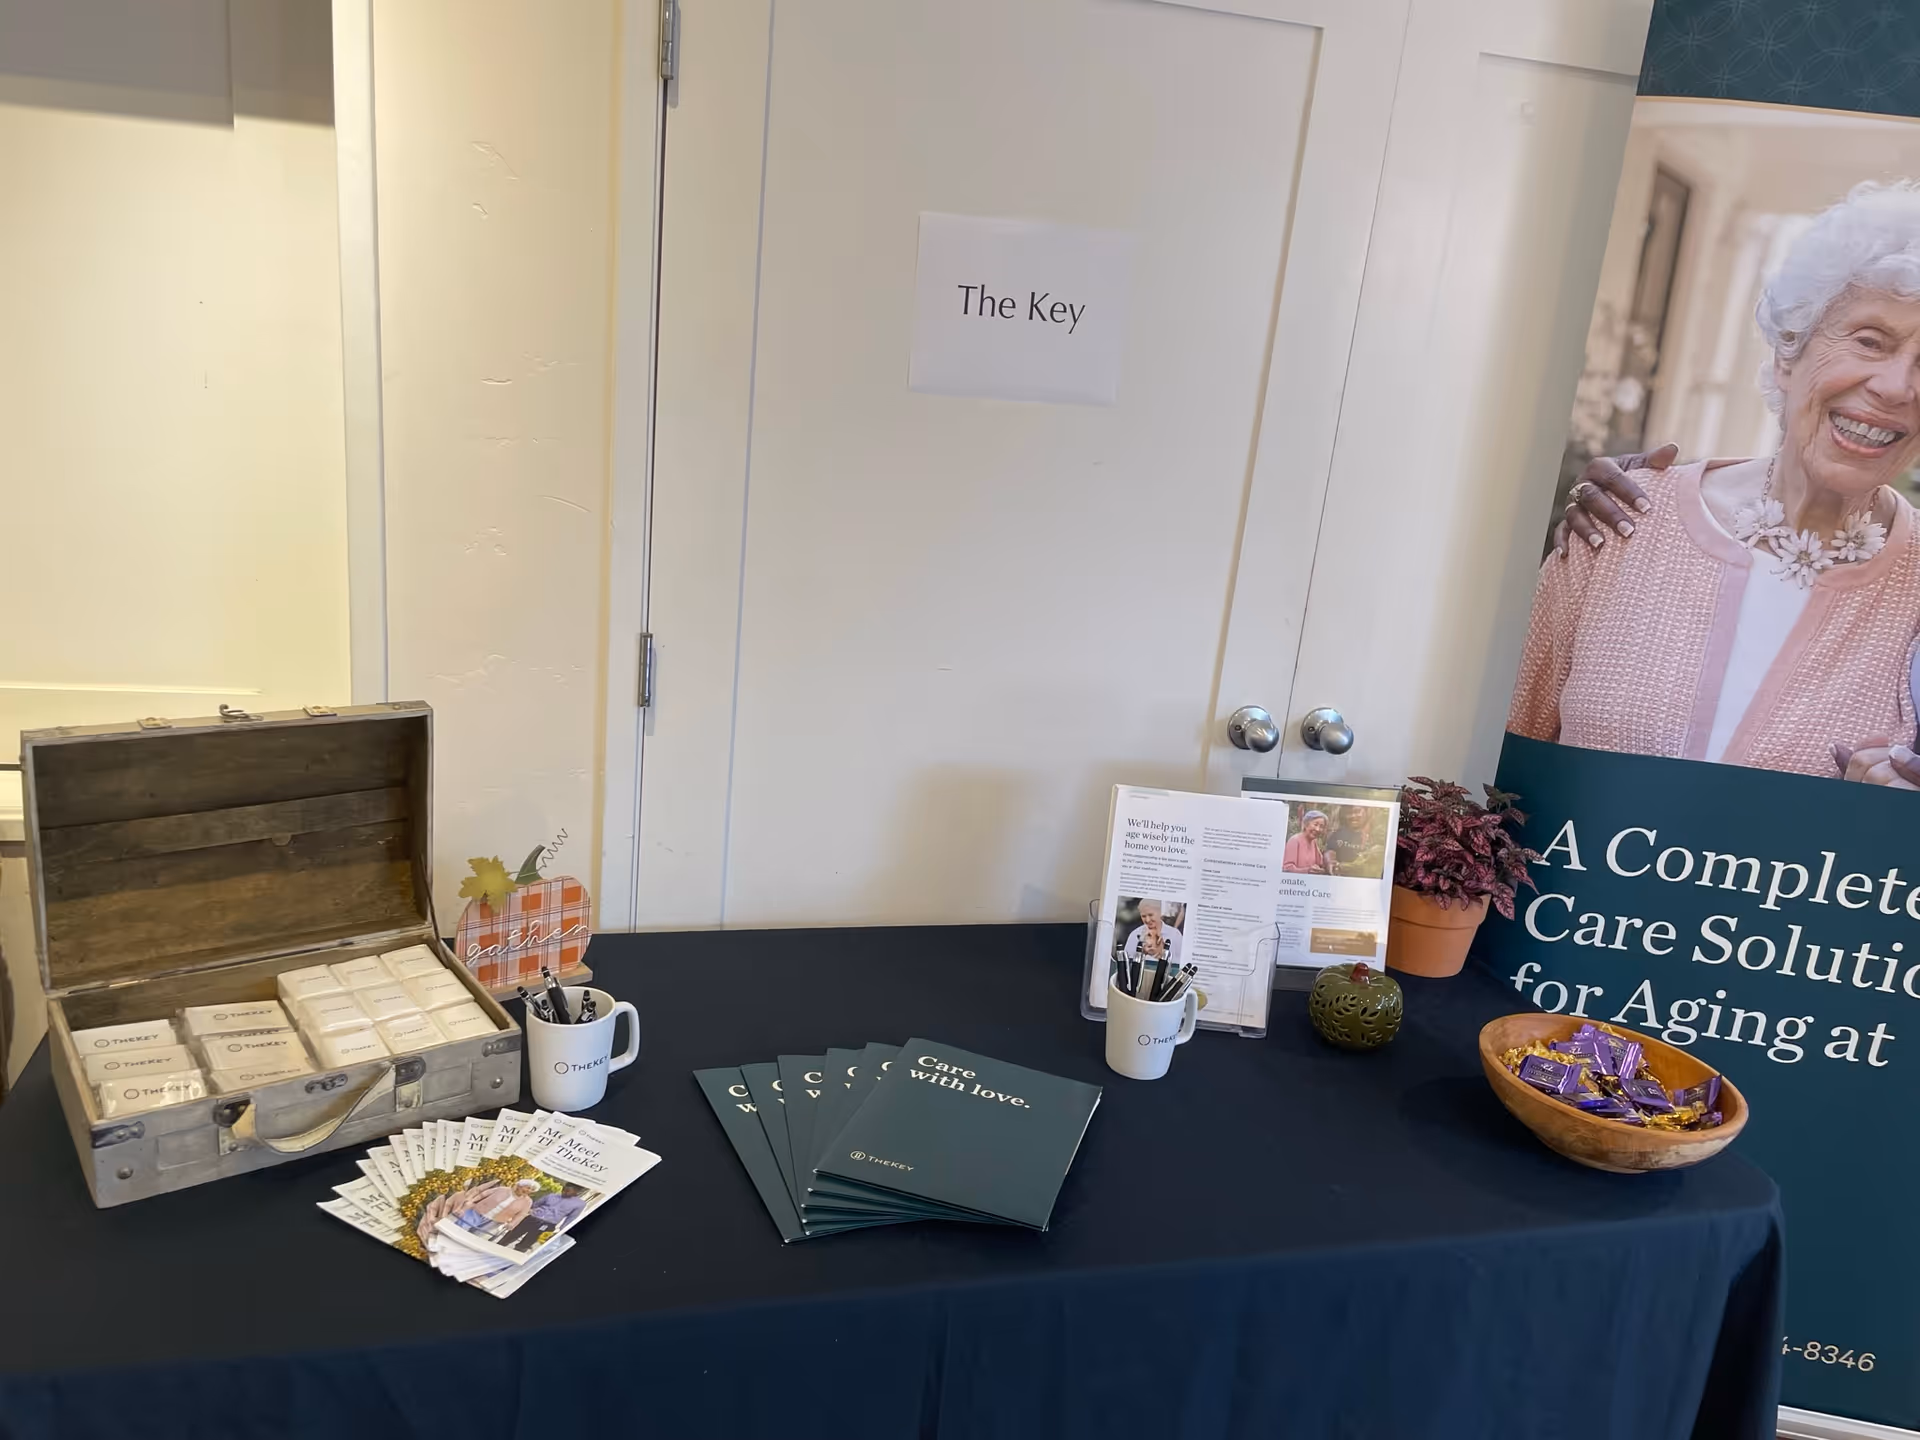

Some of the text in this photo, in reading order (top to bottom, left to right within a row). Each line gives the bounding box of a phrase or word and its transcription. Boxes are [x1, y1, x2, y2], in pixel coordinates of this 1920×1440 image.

[957, 284, 1086, 334] The Key
[1125, 831, 1141, 841] age
[1142, 831, 1169, 844] wisely
[1170, 833, 1179, 843] in
[1180, 834, 1195, 845] the
[1127, 817, 1187, 834] We'll help you
[1124, 840, 1188, 855] home you love.
[1532, 819, 1587, 872] A
[1279, 878, 1307, 887] onate,
[1311, 889, 1332, 898] Care
[1524, 893, 1678, 956] Care
[466, 919, 589, 968] gather
[1510, 962, 1896, 1067] for Aging at
[917, 1055, 976, 1080] Care
[909, 1068, 966, 1092] with
[970, 1082, 1031, 1109] love.
[556, 1144, 609, 1173] TheKey
[564, 1138, 602, 1159] Meet
